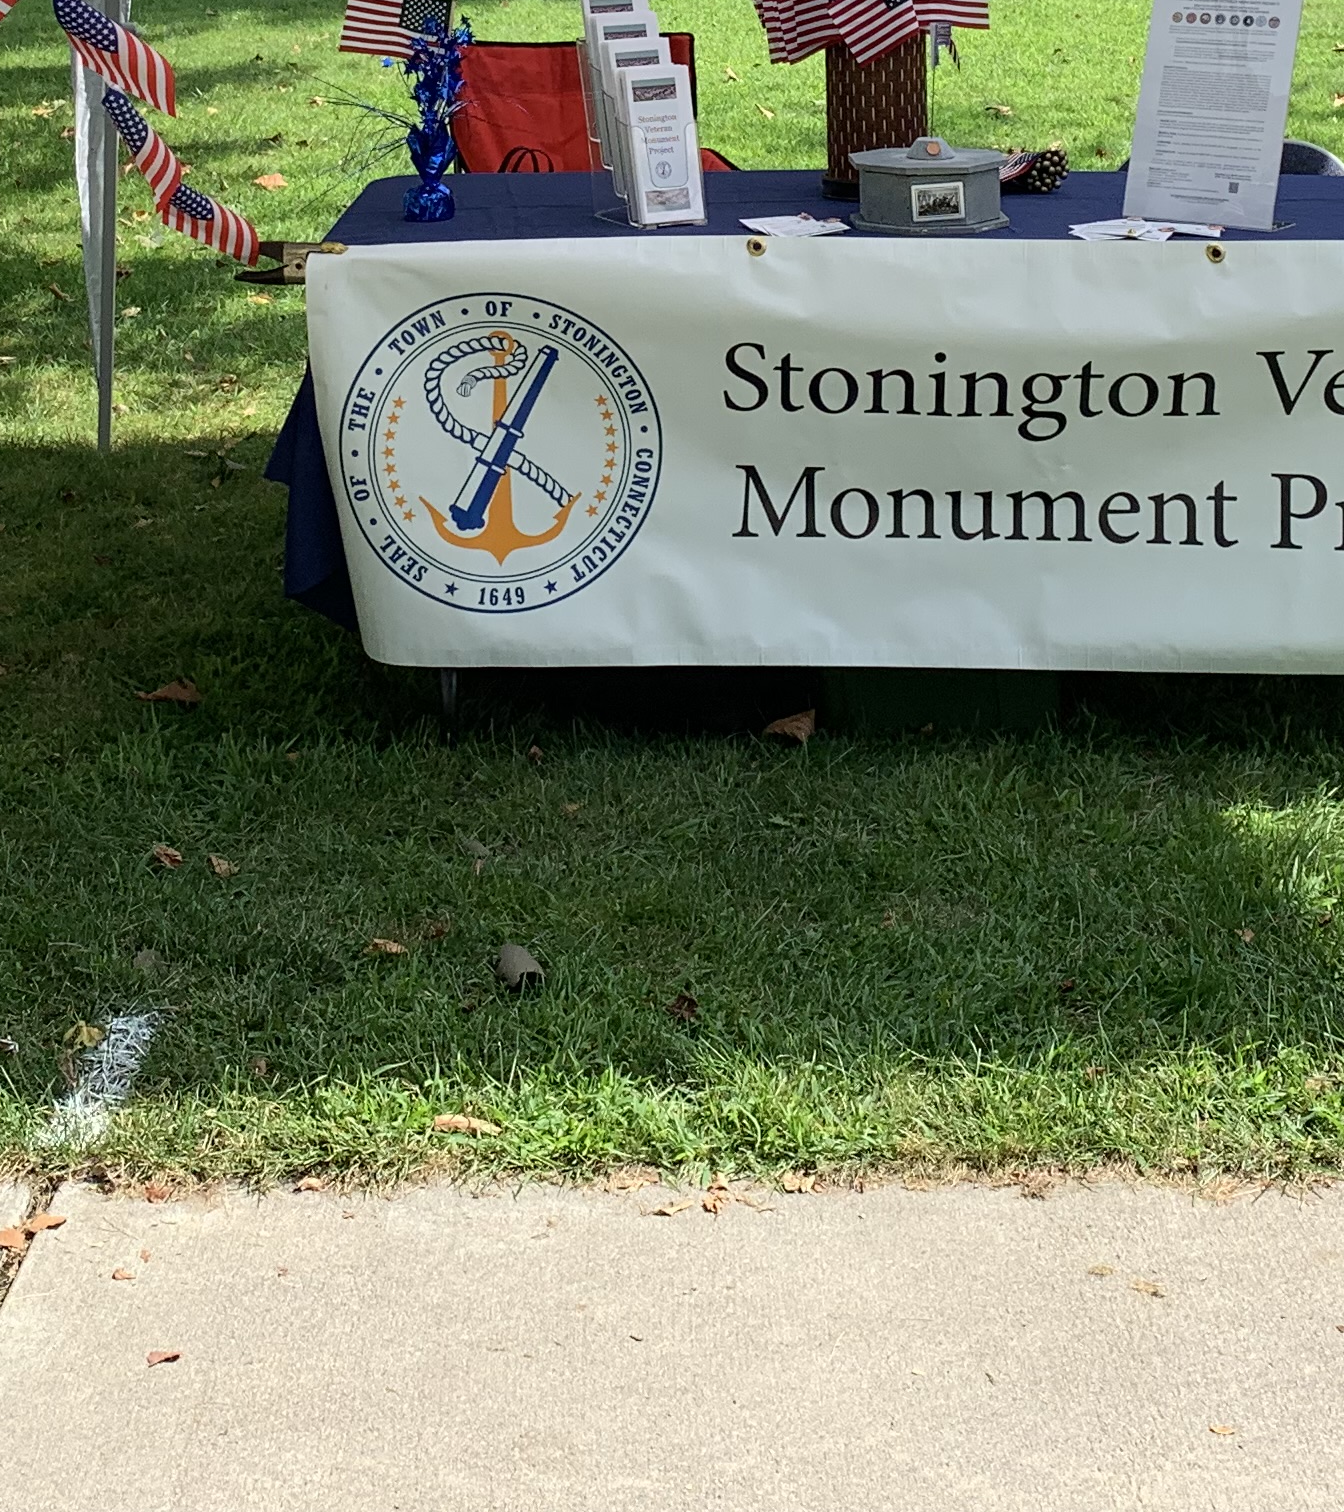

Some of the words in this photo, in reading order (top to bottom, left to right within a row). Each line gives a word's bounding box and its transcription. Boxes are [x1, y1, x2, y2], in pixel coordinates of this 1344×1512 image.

[485, 301, 513, 317] OF
[388, 310, 446, 356] TOWN
[549, 315, 648, 415] STONINGTON
[348, 387, 376, 432] THE
[723, 342, 1221, 442] Stonington
[350, 475, 370, 502] OF
[731, 464, 1239, 548] Monument
[570, 448, 654, 583] CONNECTICUT
[380, 534, 428, 583] SEAL
[478, 587, 526, 606] 1649
